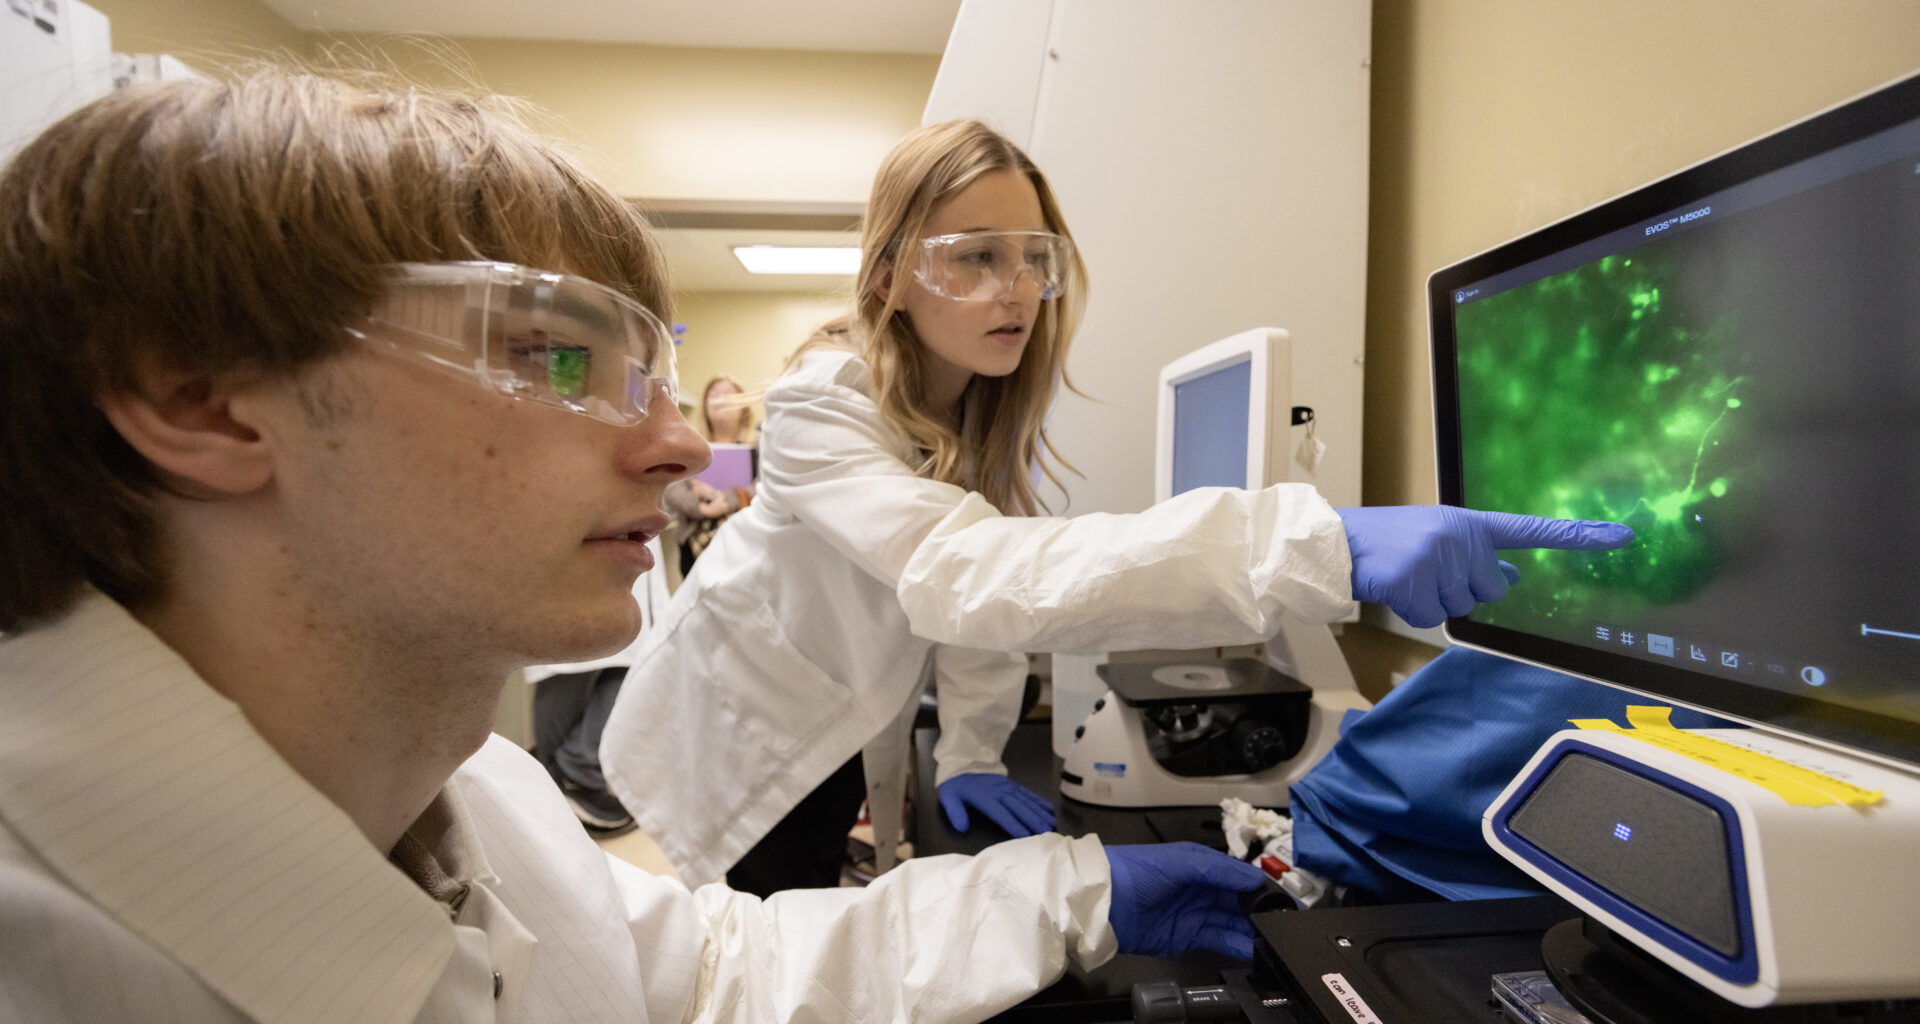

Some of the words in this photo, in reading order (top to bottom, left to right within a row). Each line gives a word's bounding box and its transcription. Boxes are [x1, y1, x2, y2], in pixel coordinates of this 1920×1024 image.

[1679, 206, 1711, 224] M5000
[1330, 979, 1346, 995] can
[1345, 997, 1366, 1018] leave
